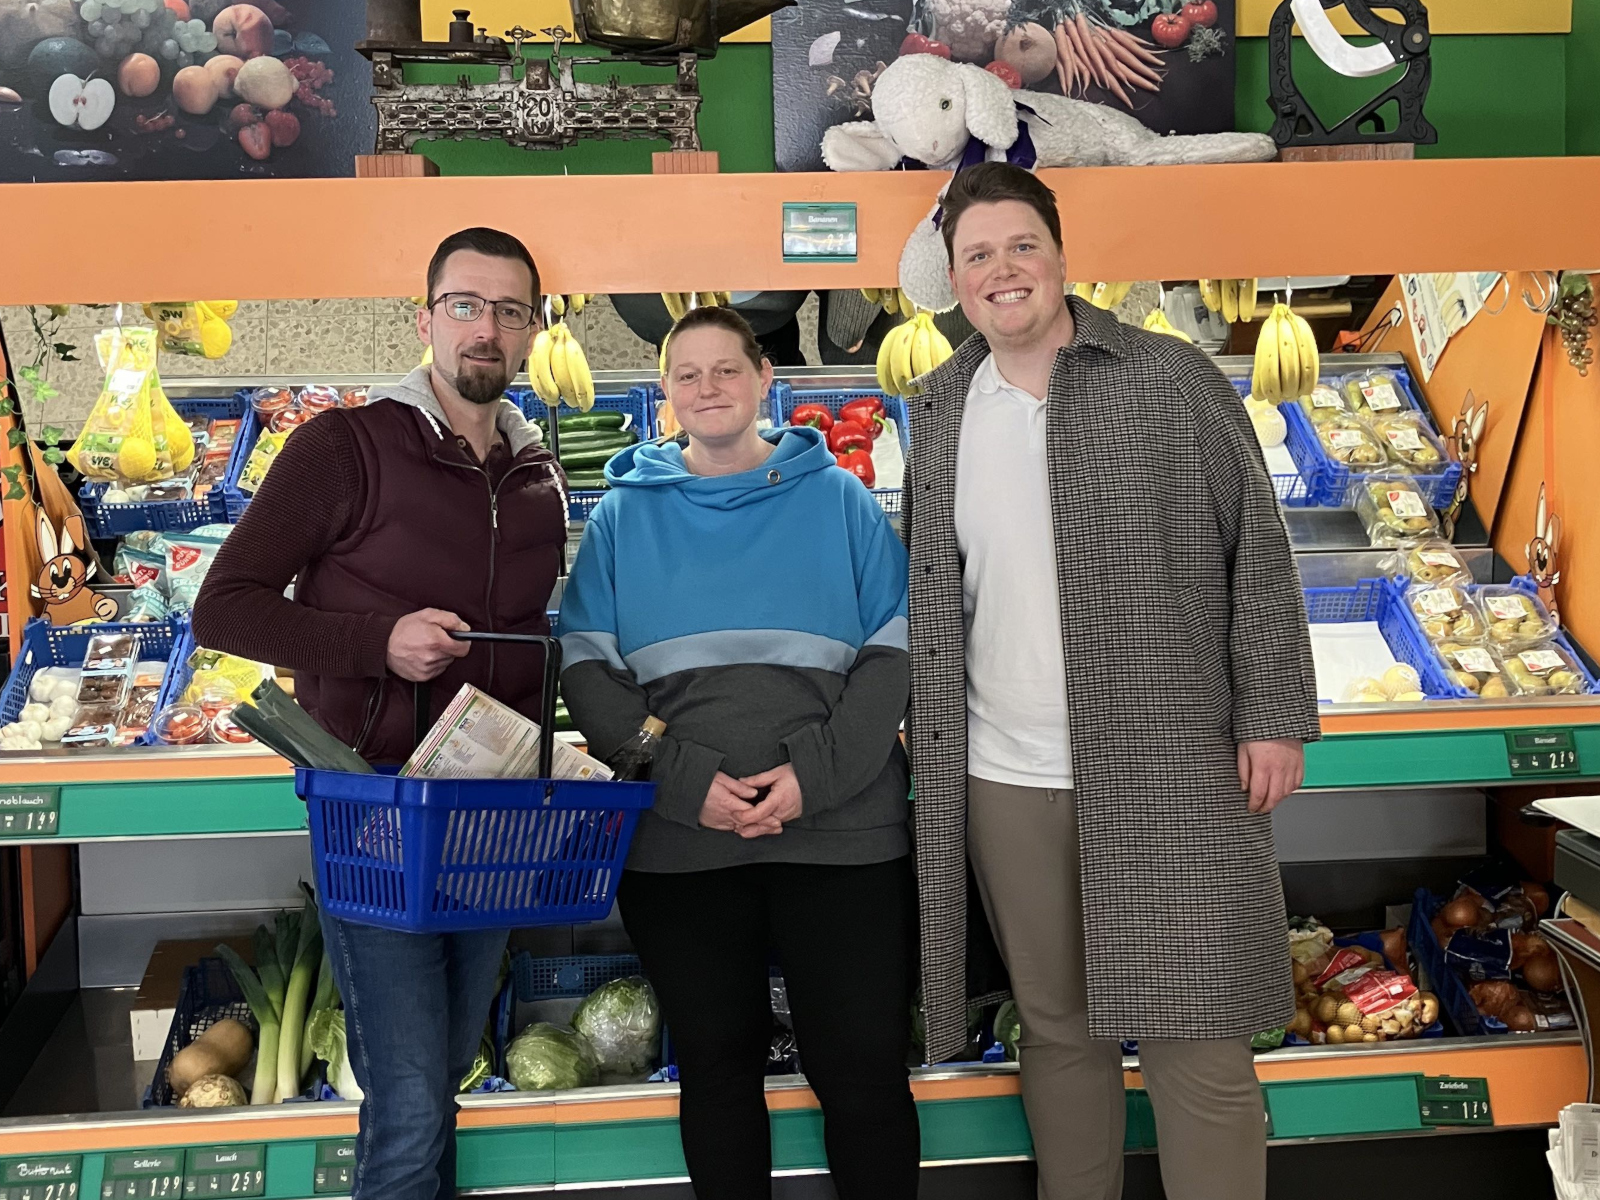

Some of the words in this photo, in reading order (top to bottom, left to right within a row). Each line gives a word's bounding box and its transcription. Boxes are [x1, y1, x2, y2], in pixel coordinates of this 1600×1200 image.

[526, 96, 551, 118] 20
[808, 215, 838, 223] Bananen
[1439, 1081, 1468, 1090] Zwiebeln
[215, 1152, 238, 1162] Lauch
[133, 1159, 161, 1169] Sellerie
[231, 1170, 262, 1192] 2.59
[151, 1176, 180, 1197] 1.99
